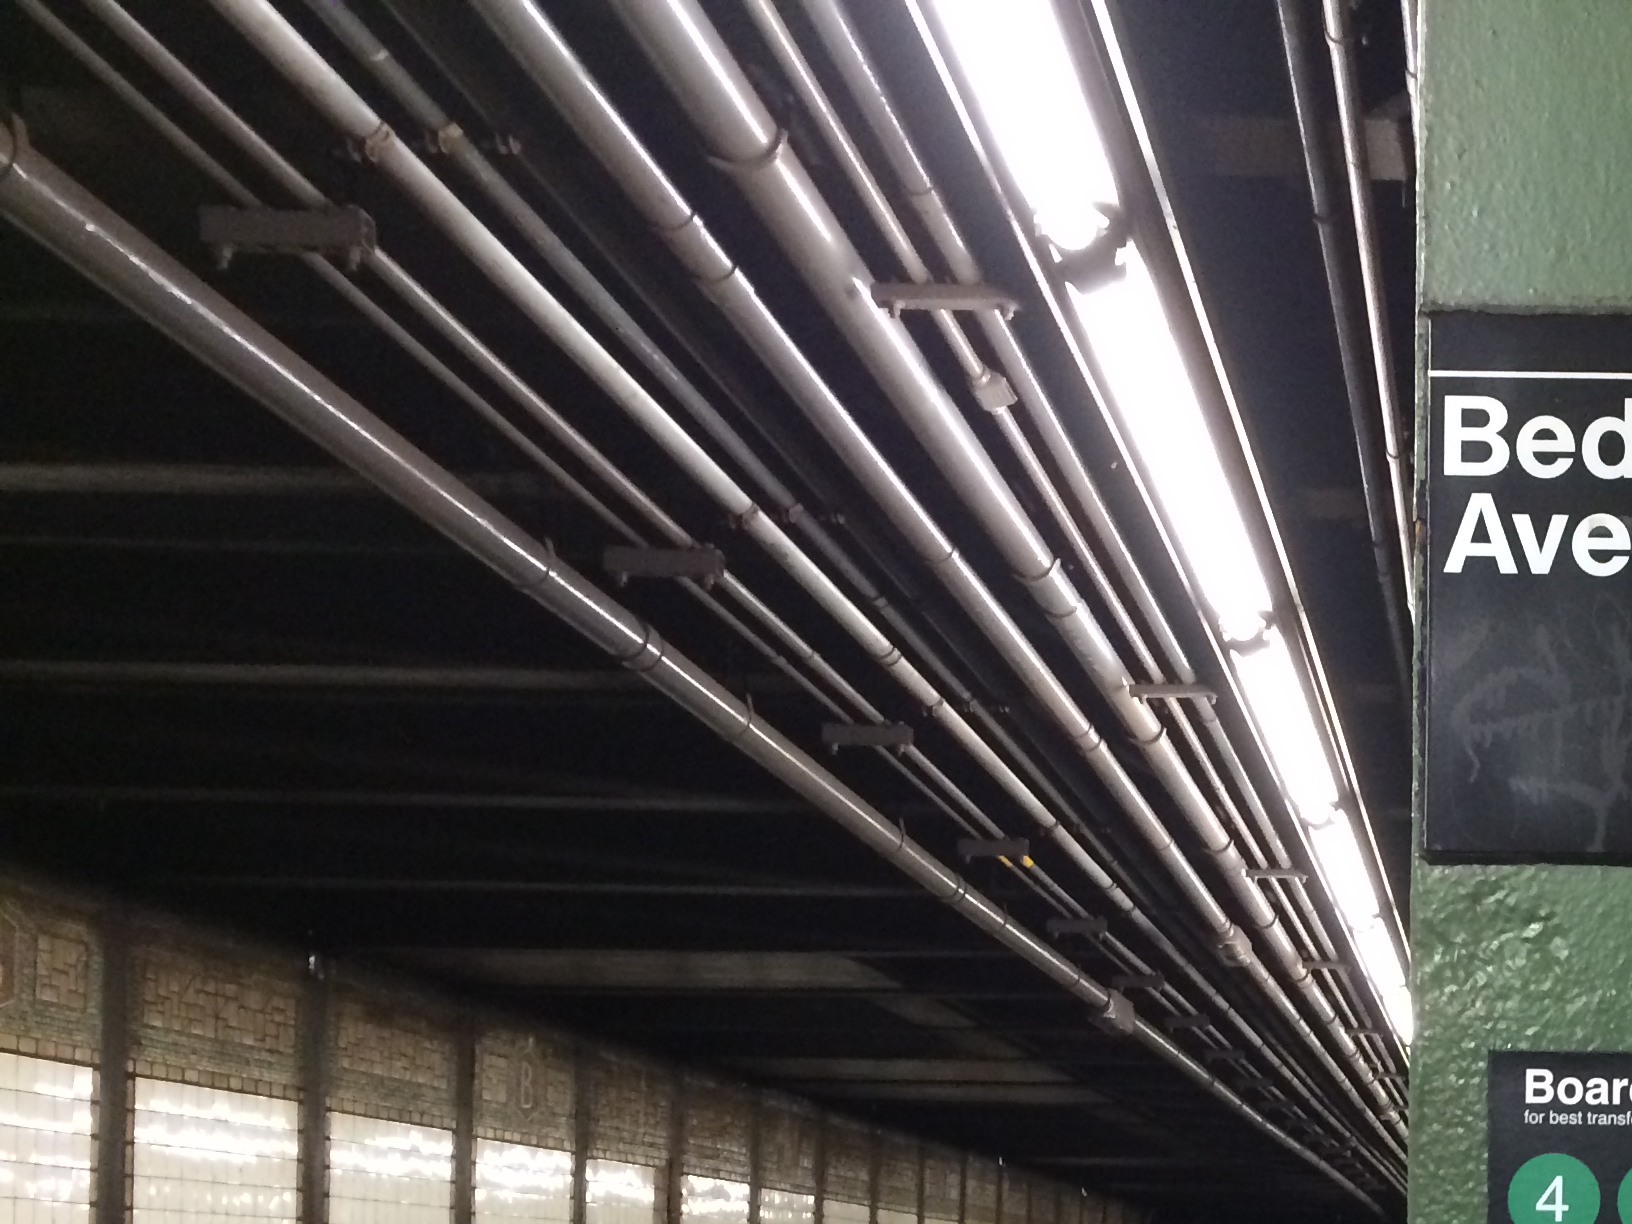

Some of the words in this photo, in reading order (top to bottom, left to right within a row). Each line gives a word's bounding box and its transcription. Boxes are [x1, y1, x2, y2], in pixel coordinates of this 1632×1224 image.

[1523, 1109, 1545, 1125] for
[1549, 1110, 1583, 1126] best
[1535, 1175, 1570, 1222] 4
